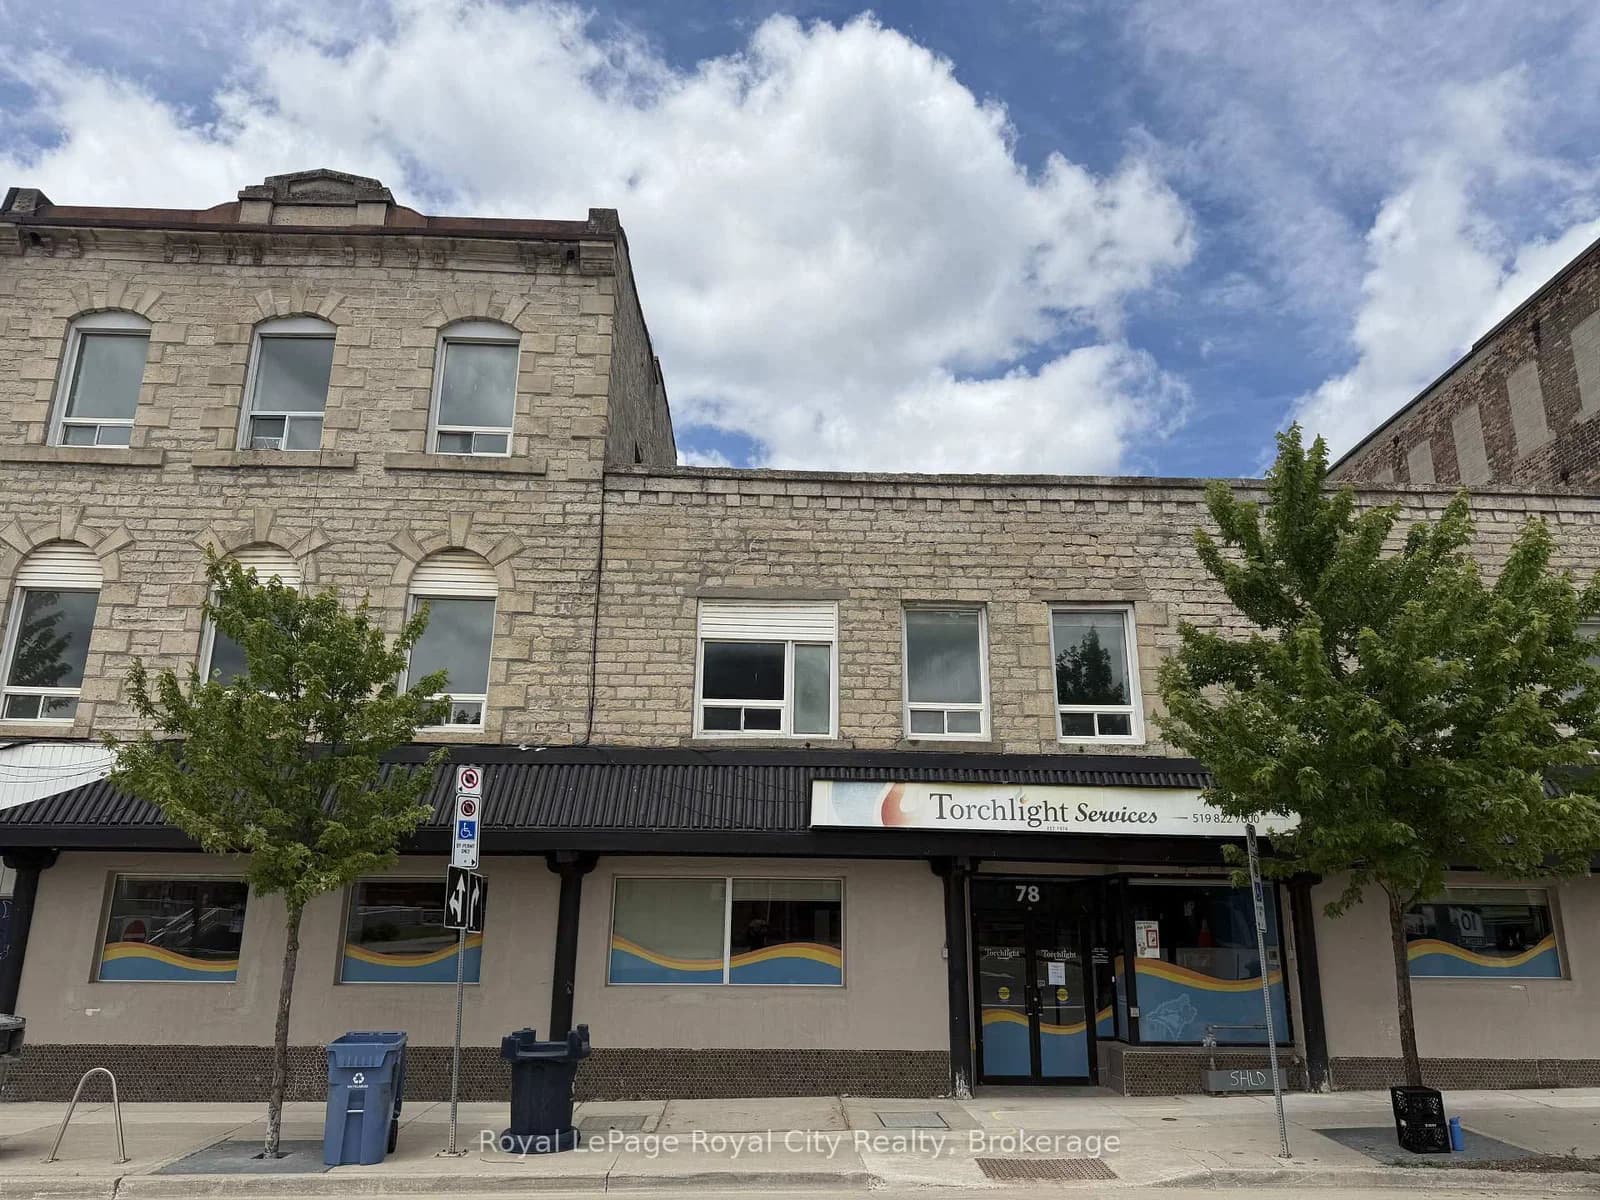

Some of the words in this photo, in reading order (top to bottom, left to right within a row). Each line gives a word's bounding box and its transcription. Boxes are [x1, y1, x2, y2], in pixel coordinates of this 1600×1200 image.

[929, 792, 1068, 828] Torchlight
[1074, 802, 1158, 824] Services
[1192, 813, 1212, 824] 519
[1015, 885, 1040, 902] 78
[985, 948, 1020, 959] Torchlight
[1041, 949, 1077, 960] Torchlight
